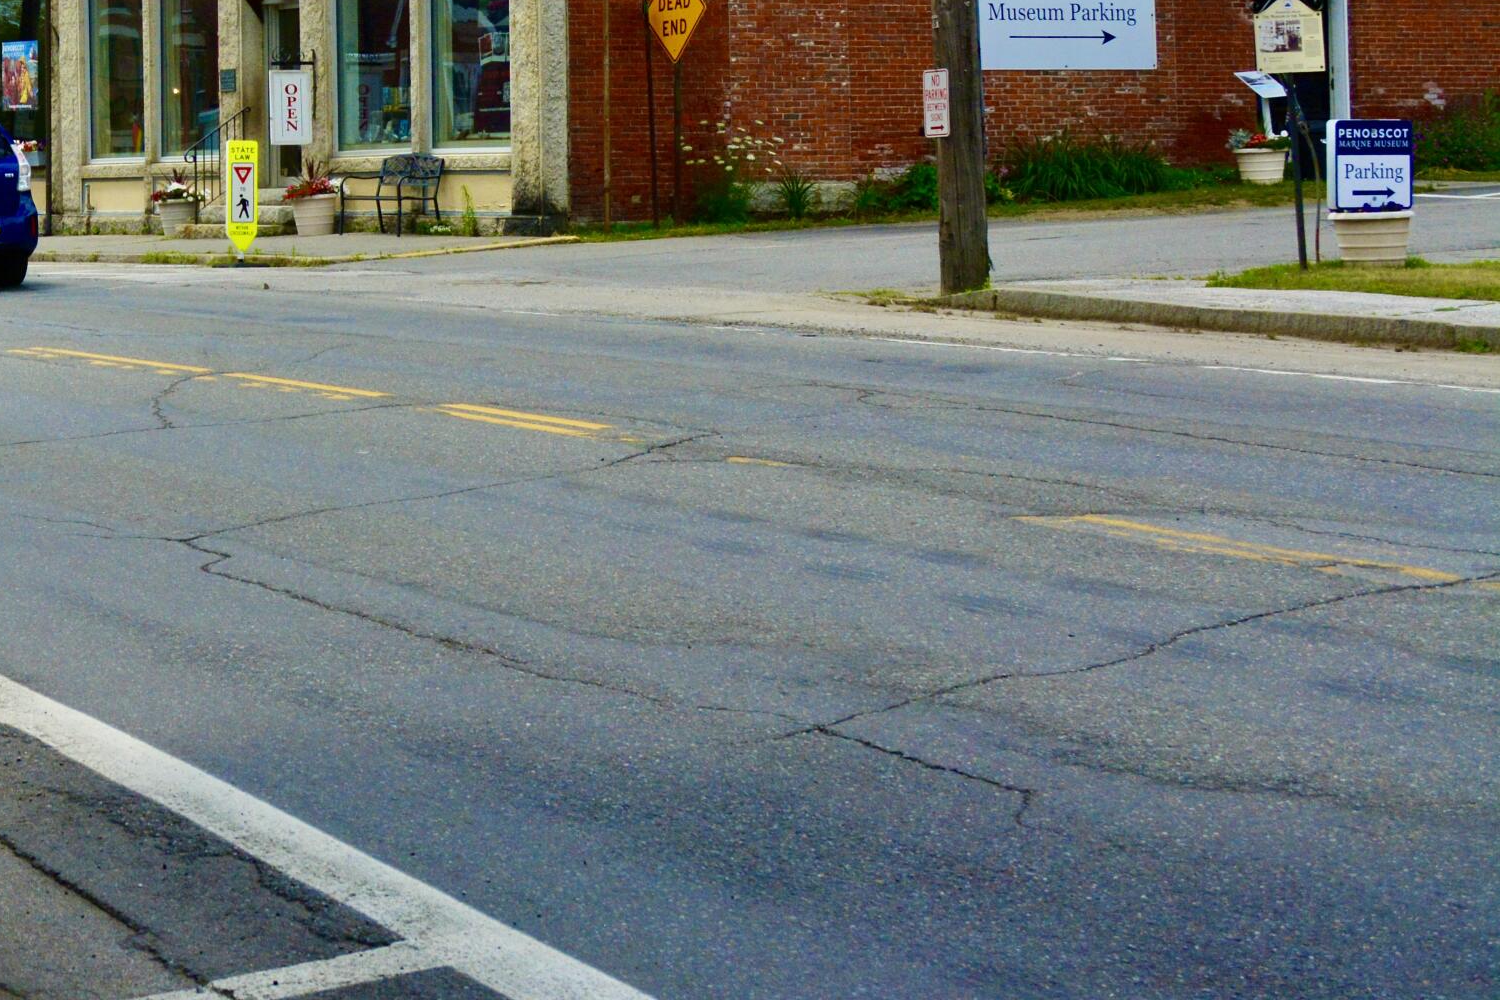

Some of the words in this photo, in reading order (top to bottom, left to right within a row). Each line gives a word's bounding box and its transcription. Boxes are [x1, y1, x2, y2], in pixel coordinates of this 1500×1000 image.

[987, 3, 1064, 21] Museum
[1069, 2, 1137, 26] Parking
[662, 19, 687, 37] END
[931, 74, 940, 86] NO
[924, 88, 947, 100] PARKING
[284, 83, 298, 131] OPEN
[1338, 128, 1409, 138] PENOBSCOT
[1338, 140, 1372, 150] MARINE
[1373, 140, 1409, 148] MUSEUM
[1344, 162, 1404, 183] Parking
